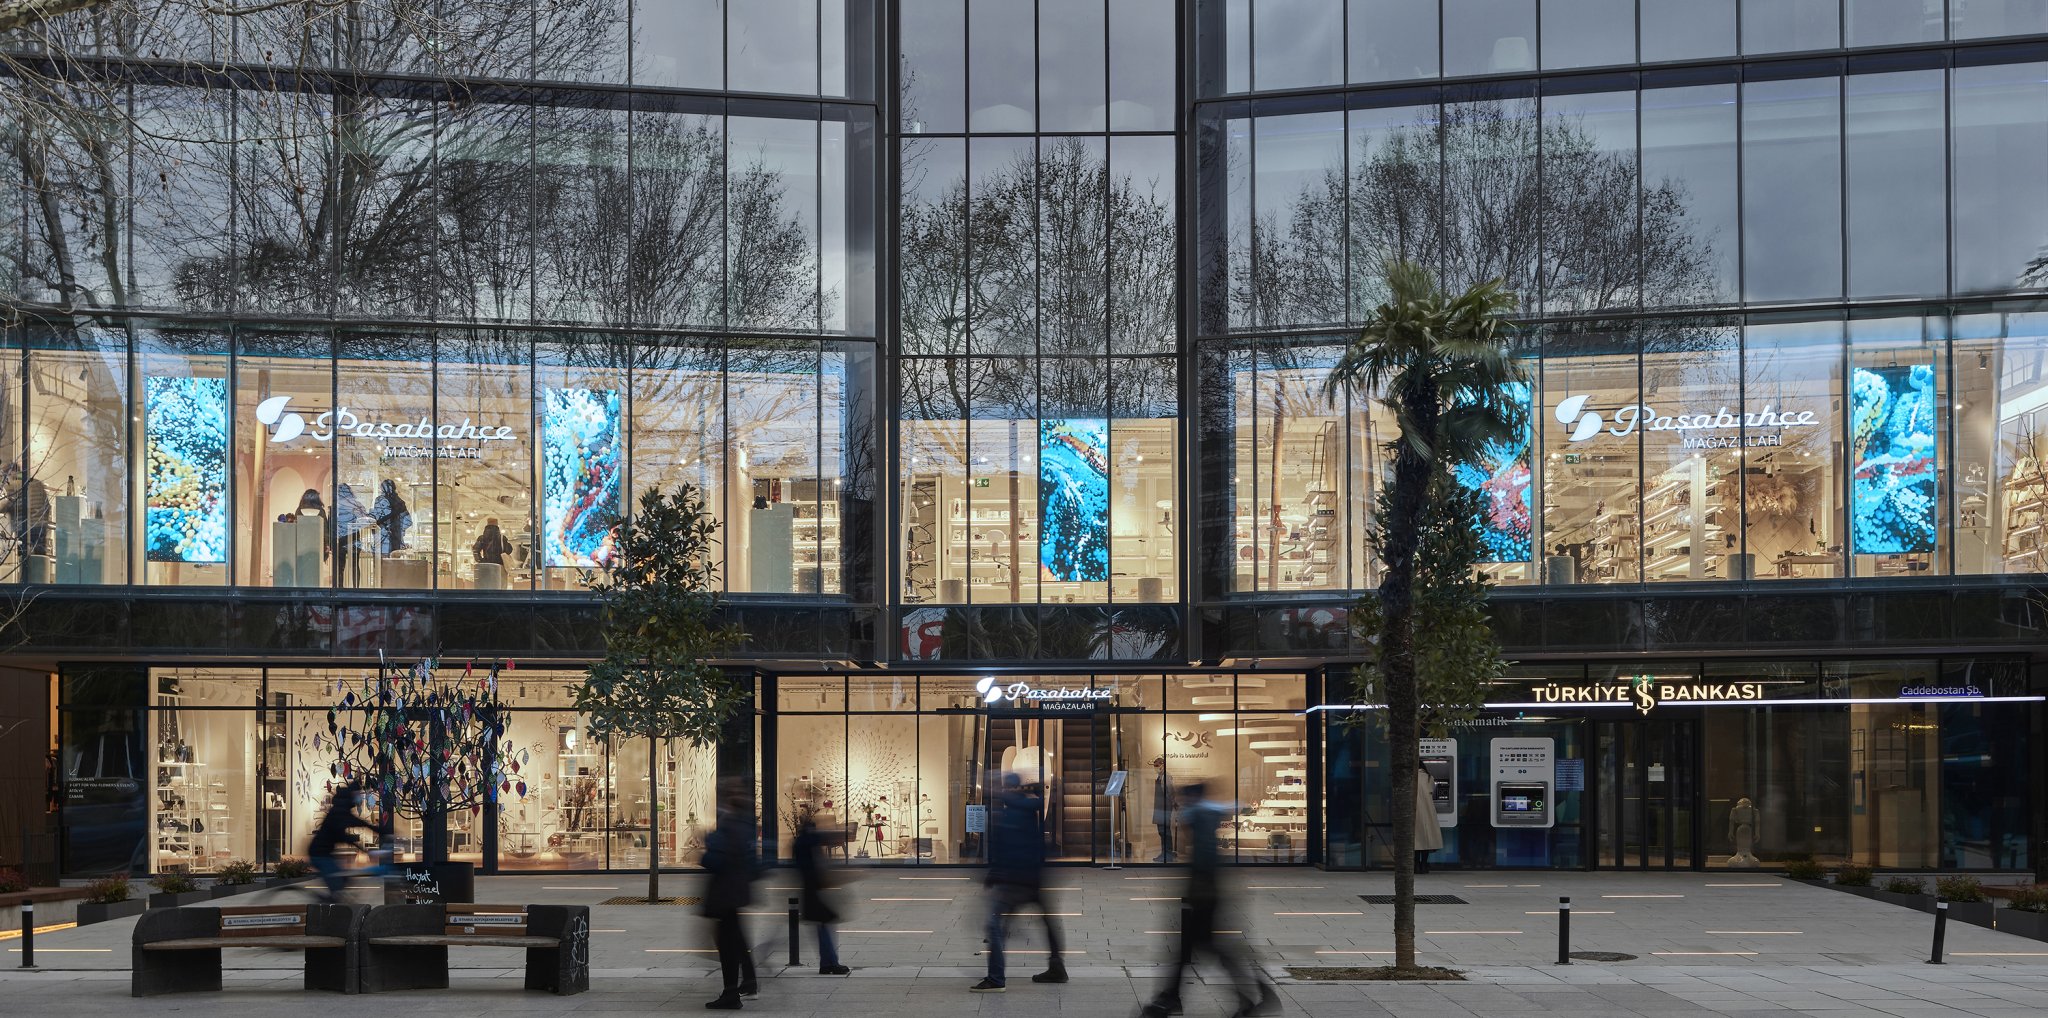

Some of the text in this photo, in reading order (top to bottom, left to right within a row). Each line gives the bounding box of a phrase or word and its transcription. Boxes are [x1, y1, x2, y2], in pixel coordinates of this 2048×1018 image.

[311, 406, 517, 442] Paşabahçe
[1609, 402, 1819, 437] Paşabahçe
[1683, 434, 1782, 449] MAĞAZLARI
[385, 446, 481, 459] MAĞAALARI
[1005, 681, 1112, 700] Paşabahçe
[1532, 682, 1629, 702] TÜRKİYE
[1661, 684, 1762, 700] BANKASI
[1901, 685, 1982, 696] Caddebostan Şb.
[1043, 702, 1095, 710] MAĞAZALARI
[406, 867, 431, 884] Hayat
[413, 881, 440, 895] Güzel
